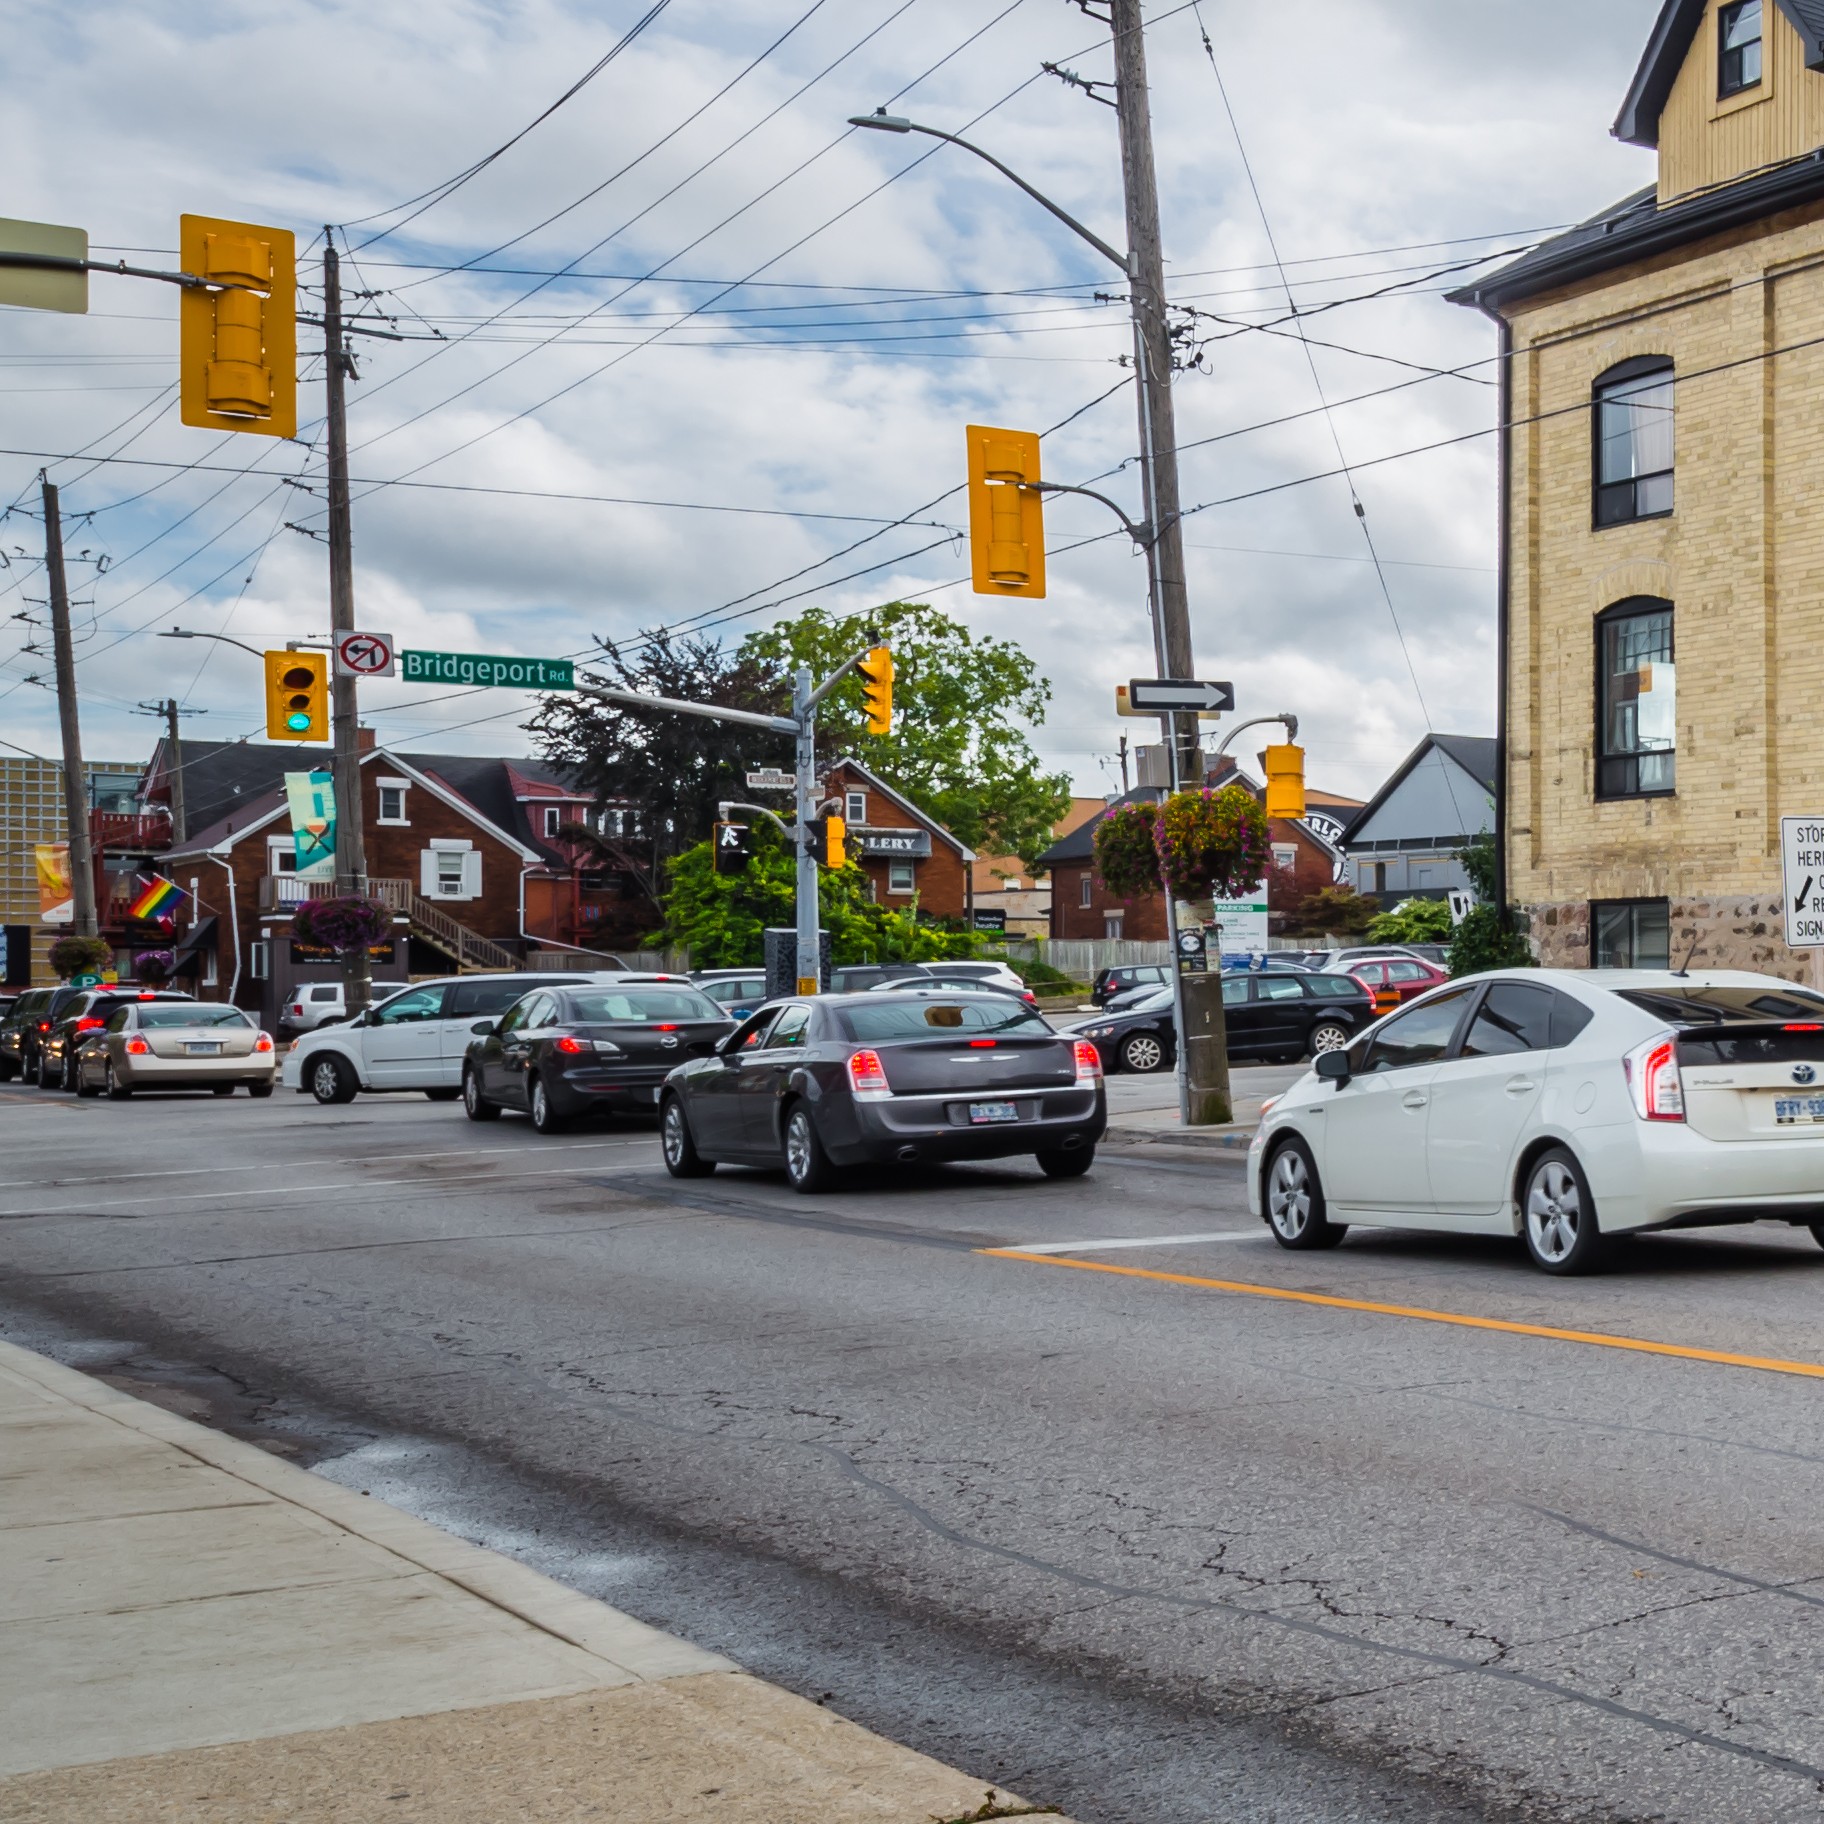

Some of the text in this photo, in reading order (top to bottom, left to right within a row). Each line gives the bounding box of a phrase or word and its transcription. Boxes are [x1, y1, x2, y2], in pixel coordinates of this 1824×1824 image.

[407, 653, 569, 686] Bridgeport Rd.
[1216, 904, 1254, 912] PARKING
